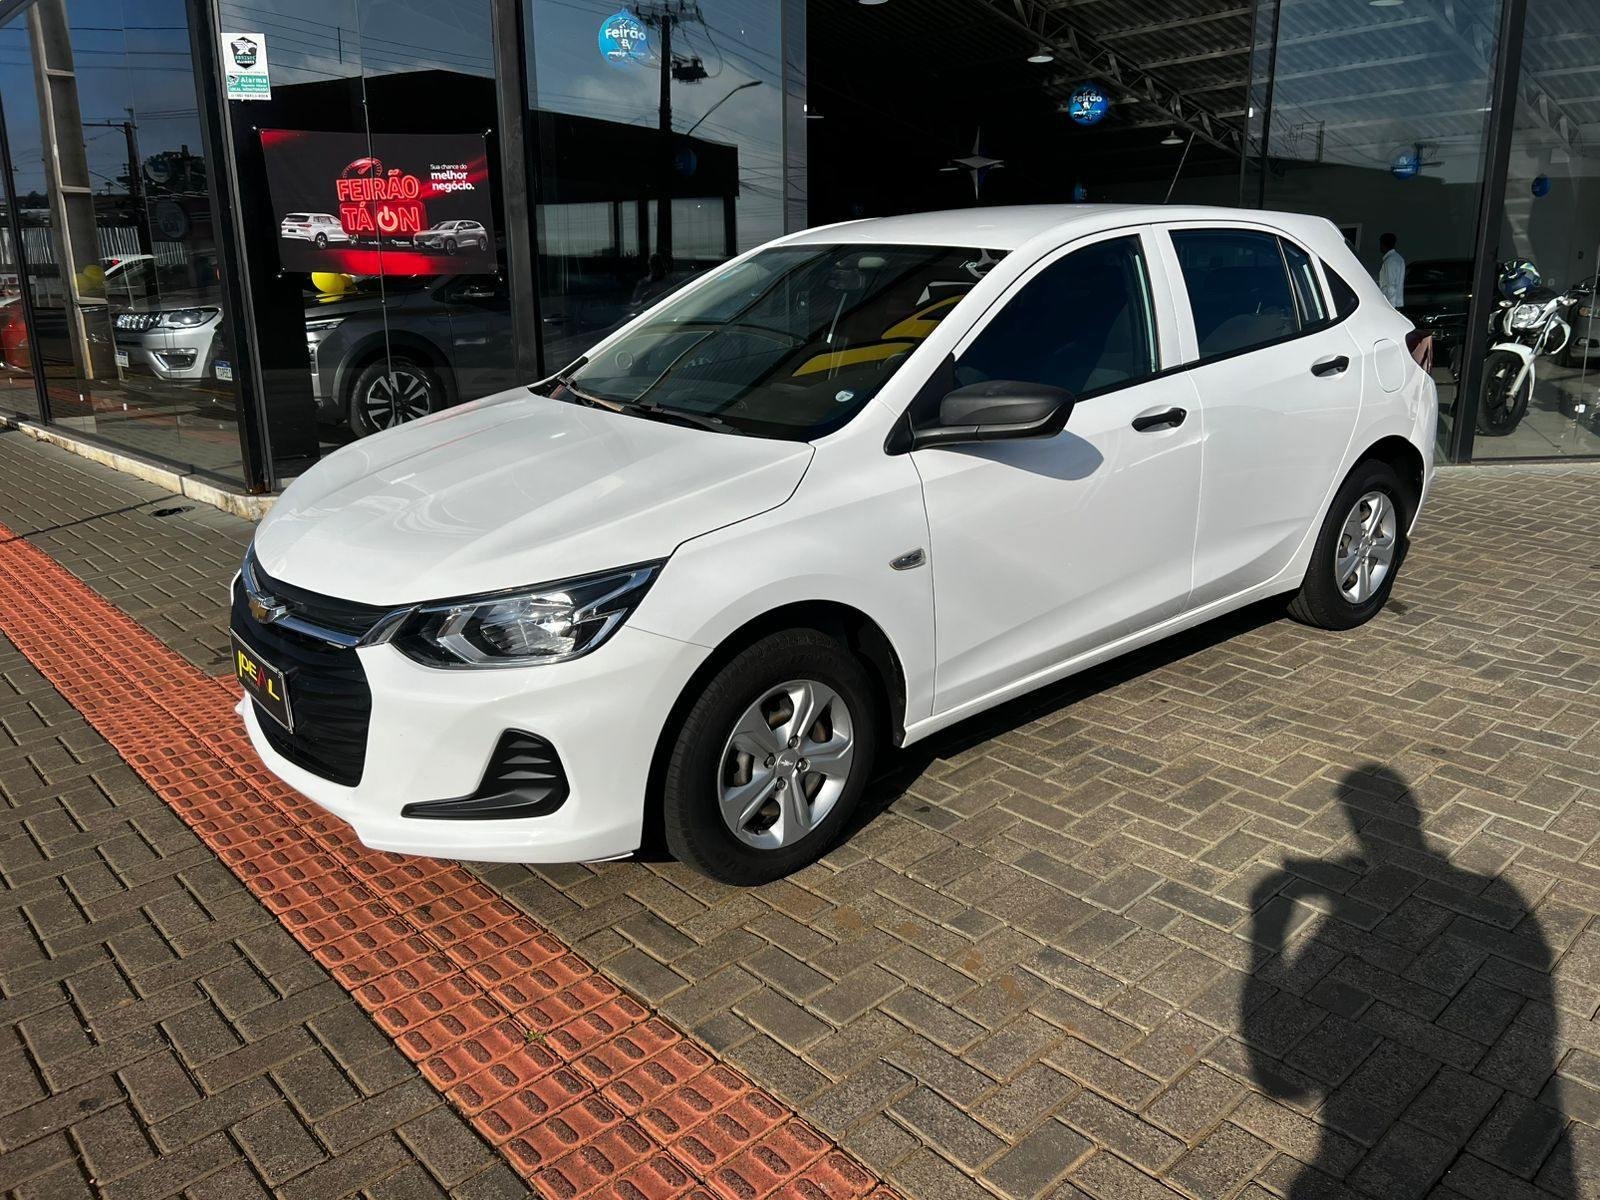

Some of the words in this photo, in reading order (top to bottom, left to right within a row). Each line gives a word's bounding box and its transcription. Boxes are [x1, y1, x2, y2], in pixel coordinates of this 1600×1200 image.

[605, 26, 646, 41] Feirão
[1072, 92, 1103, 104] Feirão
[430, 170, 468, 180] melhor
[336, 168, 420, 201] FEIRÃO
[431, 180, 476, 193] negócio.
[341, 201, 375, 231] TÁ
[376, 205, 421, 232] ON
[237, 650, 280, 701] IDEAL
